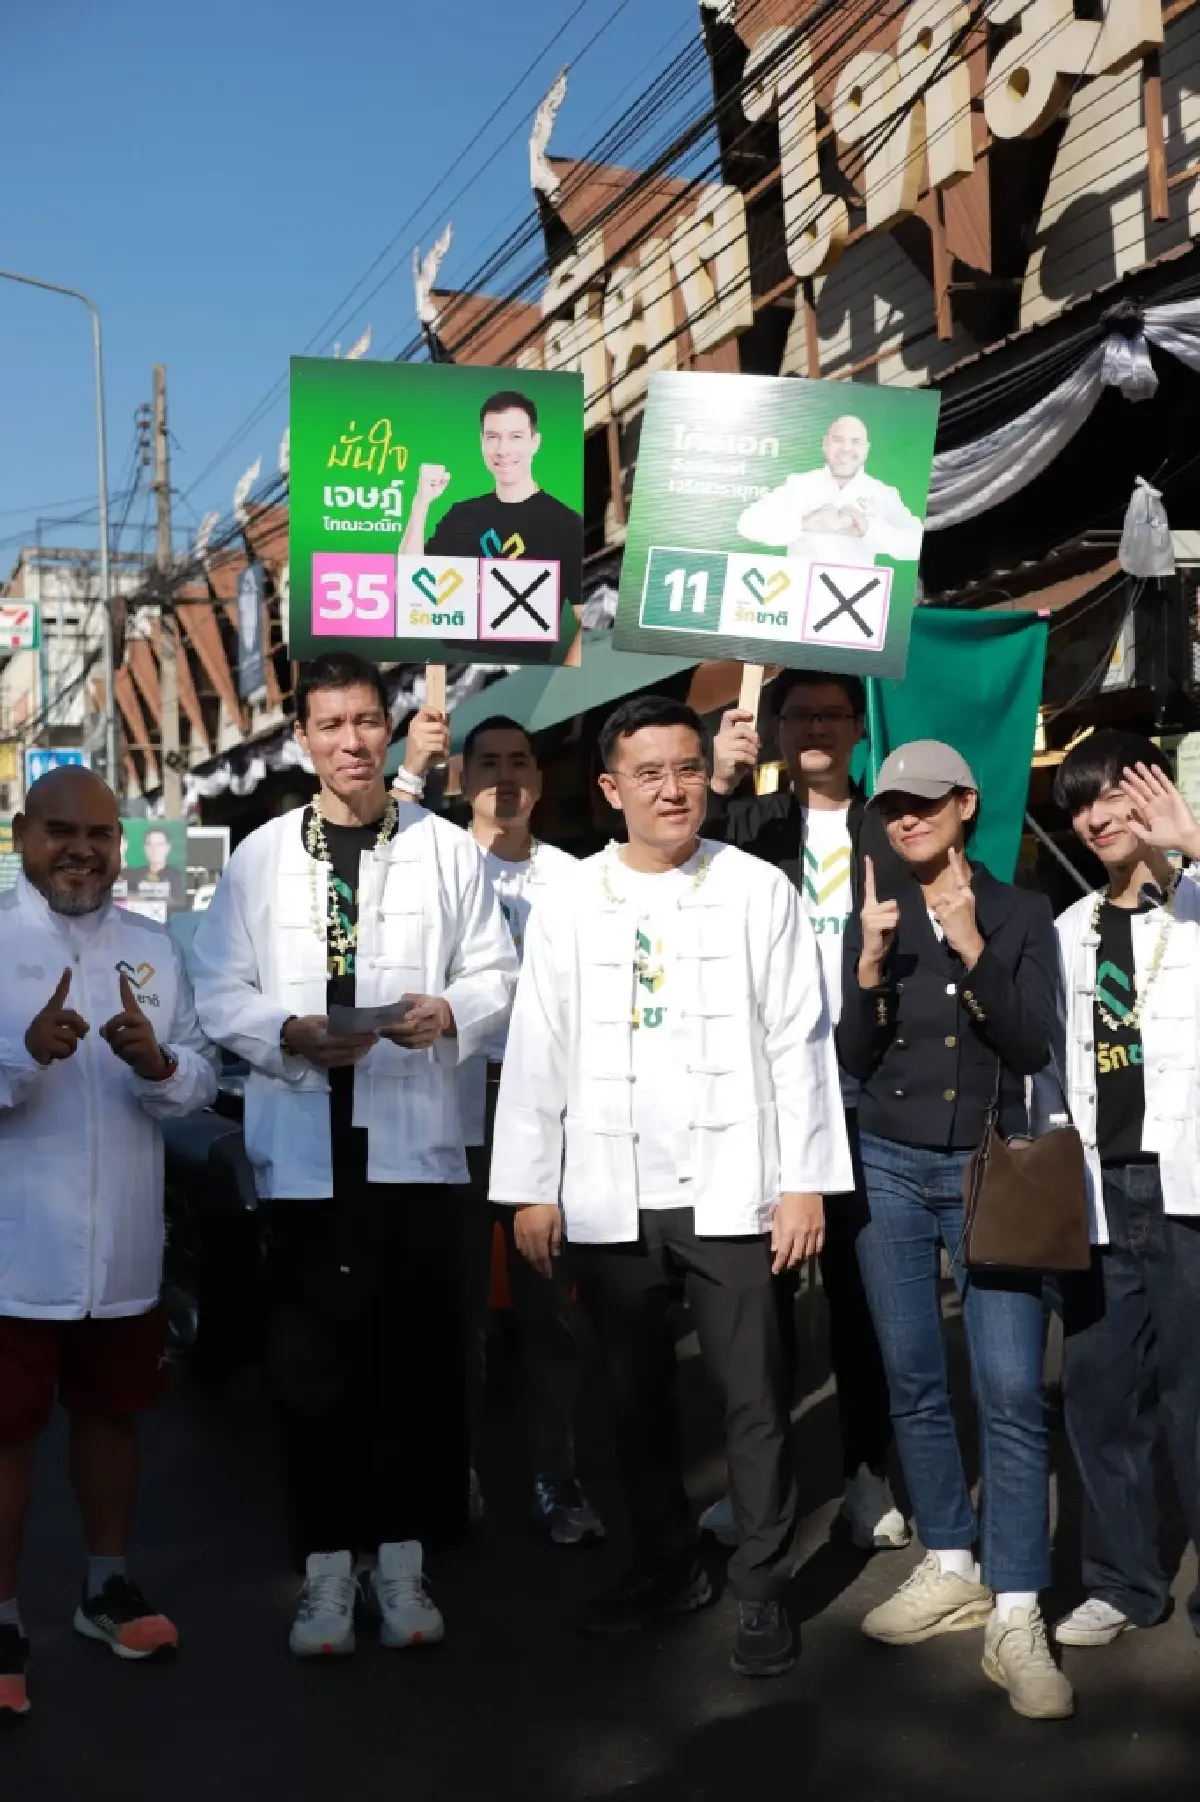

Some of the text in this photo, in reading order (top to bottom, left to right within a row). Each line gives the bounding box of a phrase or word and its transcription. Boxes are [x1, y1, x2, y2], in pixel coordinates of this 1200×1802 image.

[327, 418, 409, 475] มั่นใจ
[319, 572, 390, 620] 35
[664, 567, 709, 613] 11
[409, 608, 465, 626] รักชาติ
